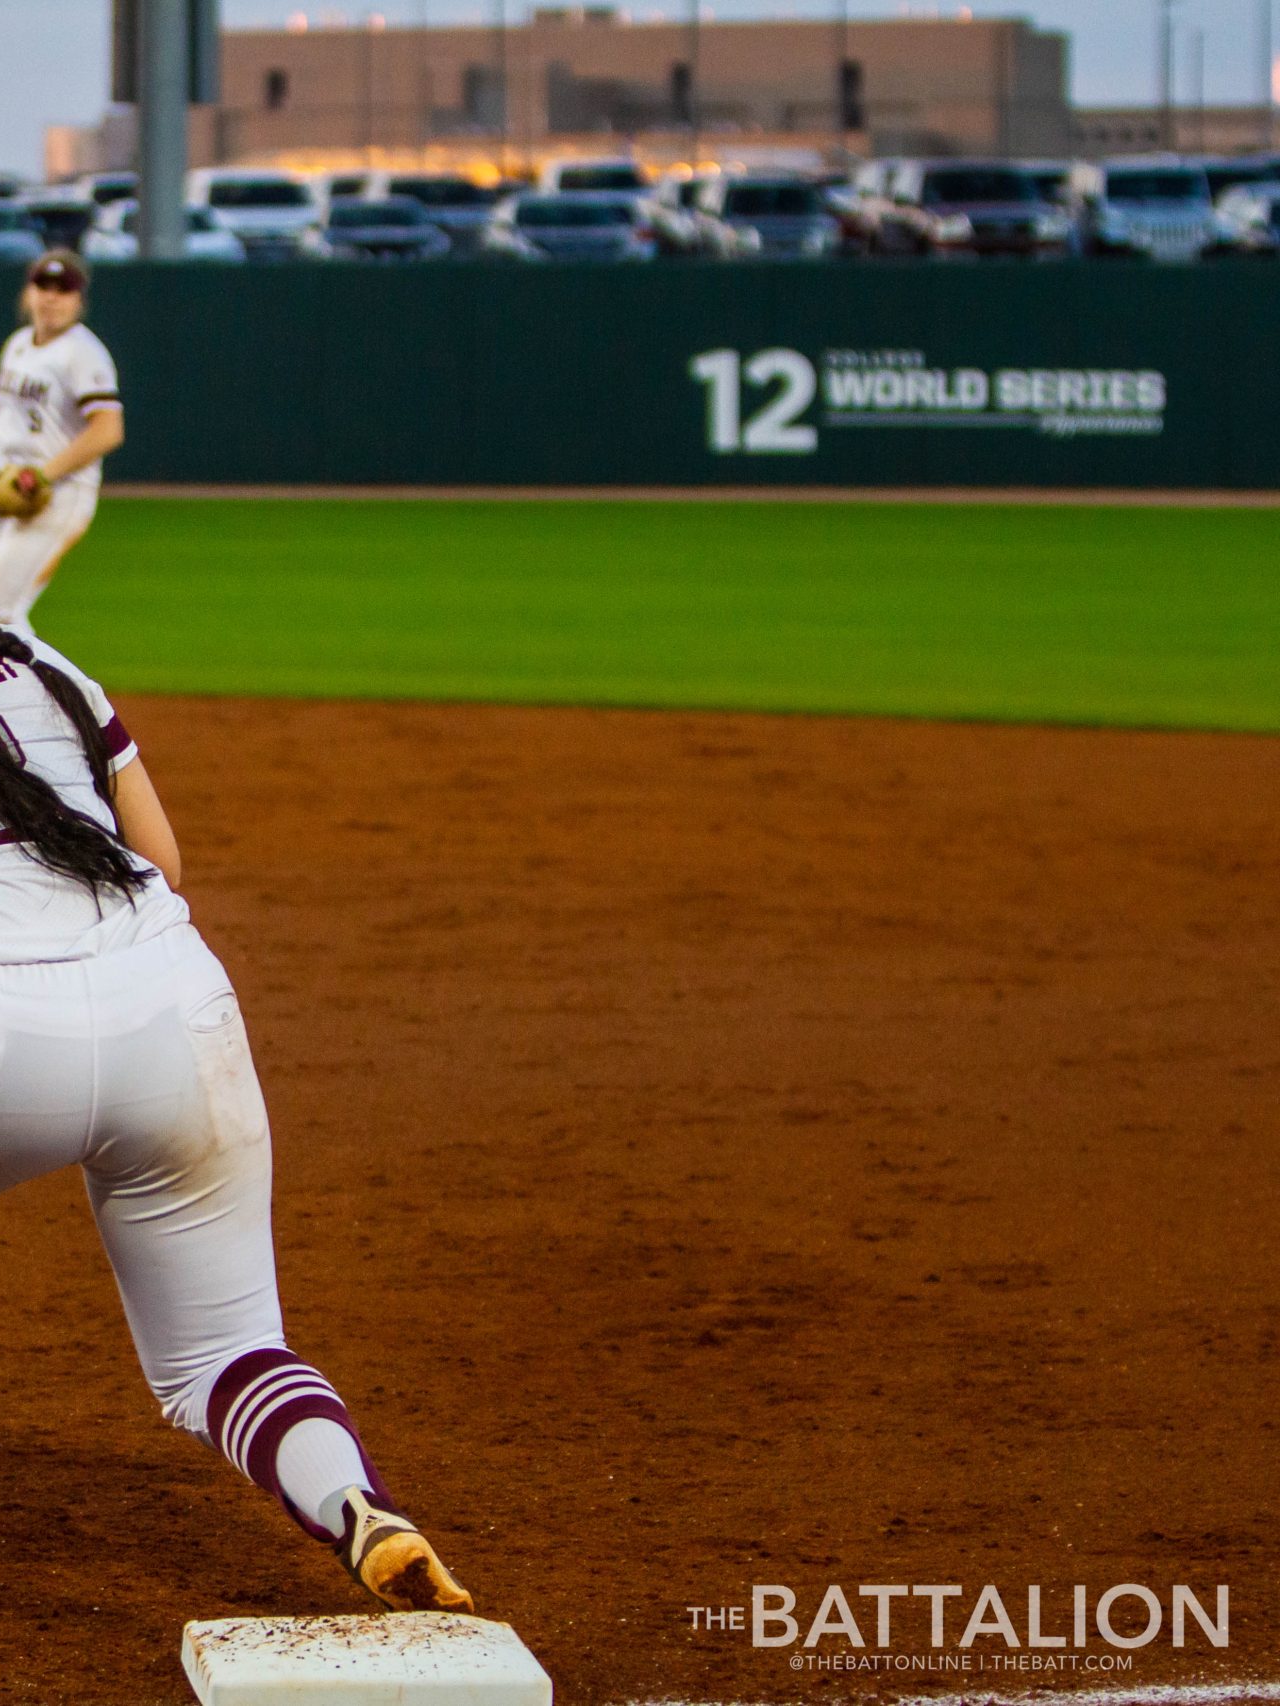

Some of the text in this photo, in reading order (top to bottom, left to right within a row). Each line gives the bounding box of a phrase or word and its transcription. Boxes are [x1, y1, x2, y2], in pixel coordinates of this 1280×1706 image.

[691, 347, 818, 454] 12
[825, 369, 1166, 411] WORLD SERIES
